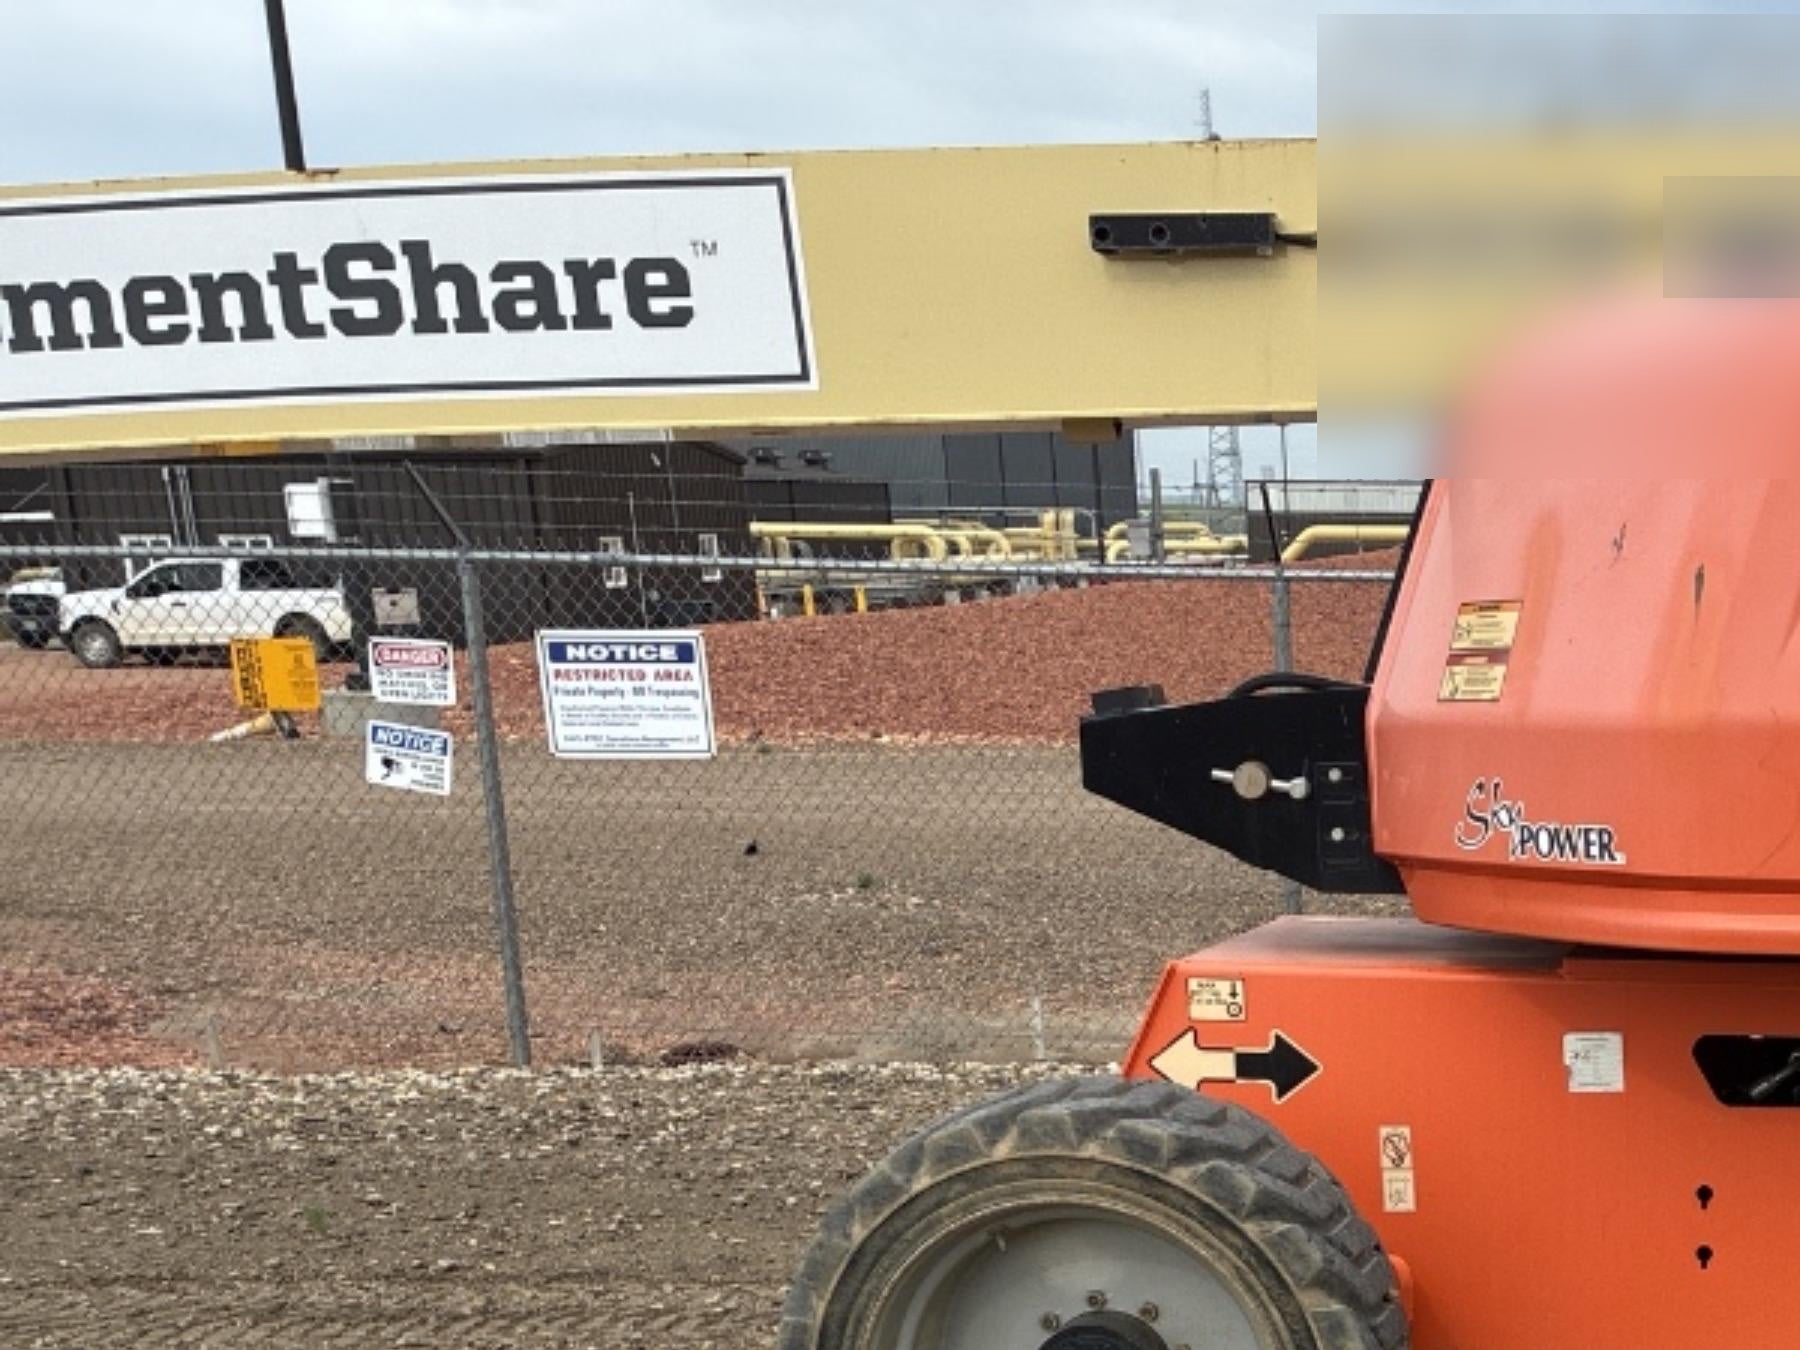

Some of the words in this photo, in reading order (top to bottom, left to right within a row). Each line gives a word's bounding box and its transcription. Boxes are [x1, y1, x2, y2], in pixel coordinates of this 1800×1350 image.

[0, 239, 696, 353] mentShare
[566, 643, 679, 661] NOTICE
[554, 669, 646, 682] RESTRICTED
[654, 669, 694, 682] AREA
[1519, 824, 1618, 862] POWER
